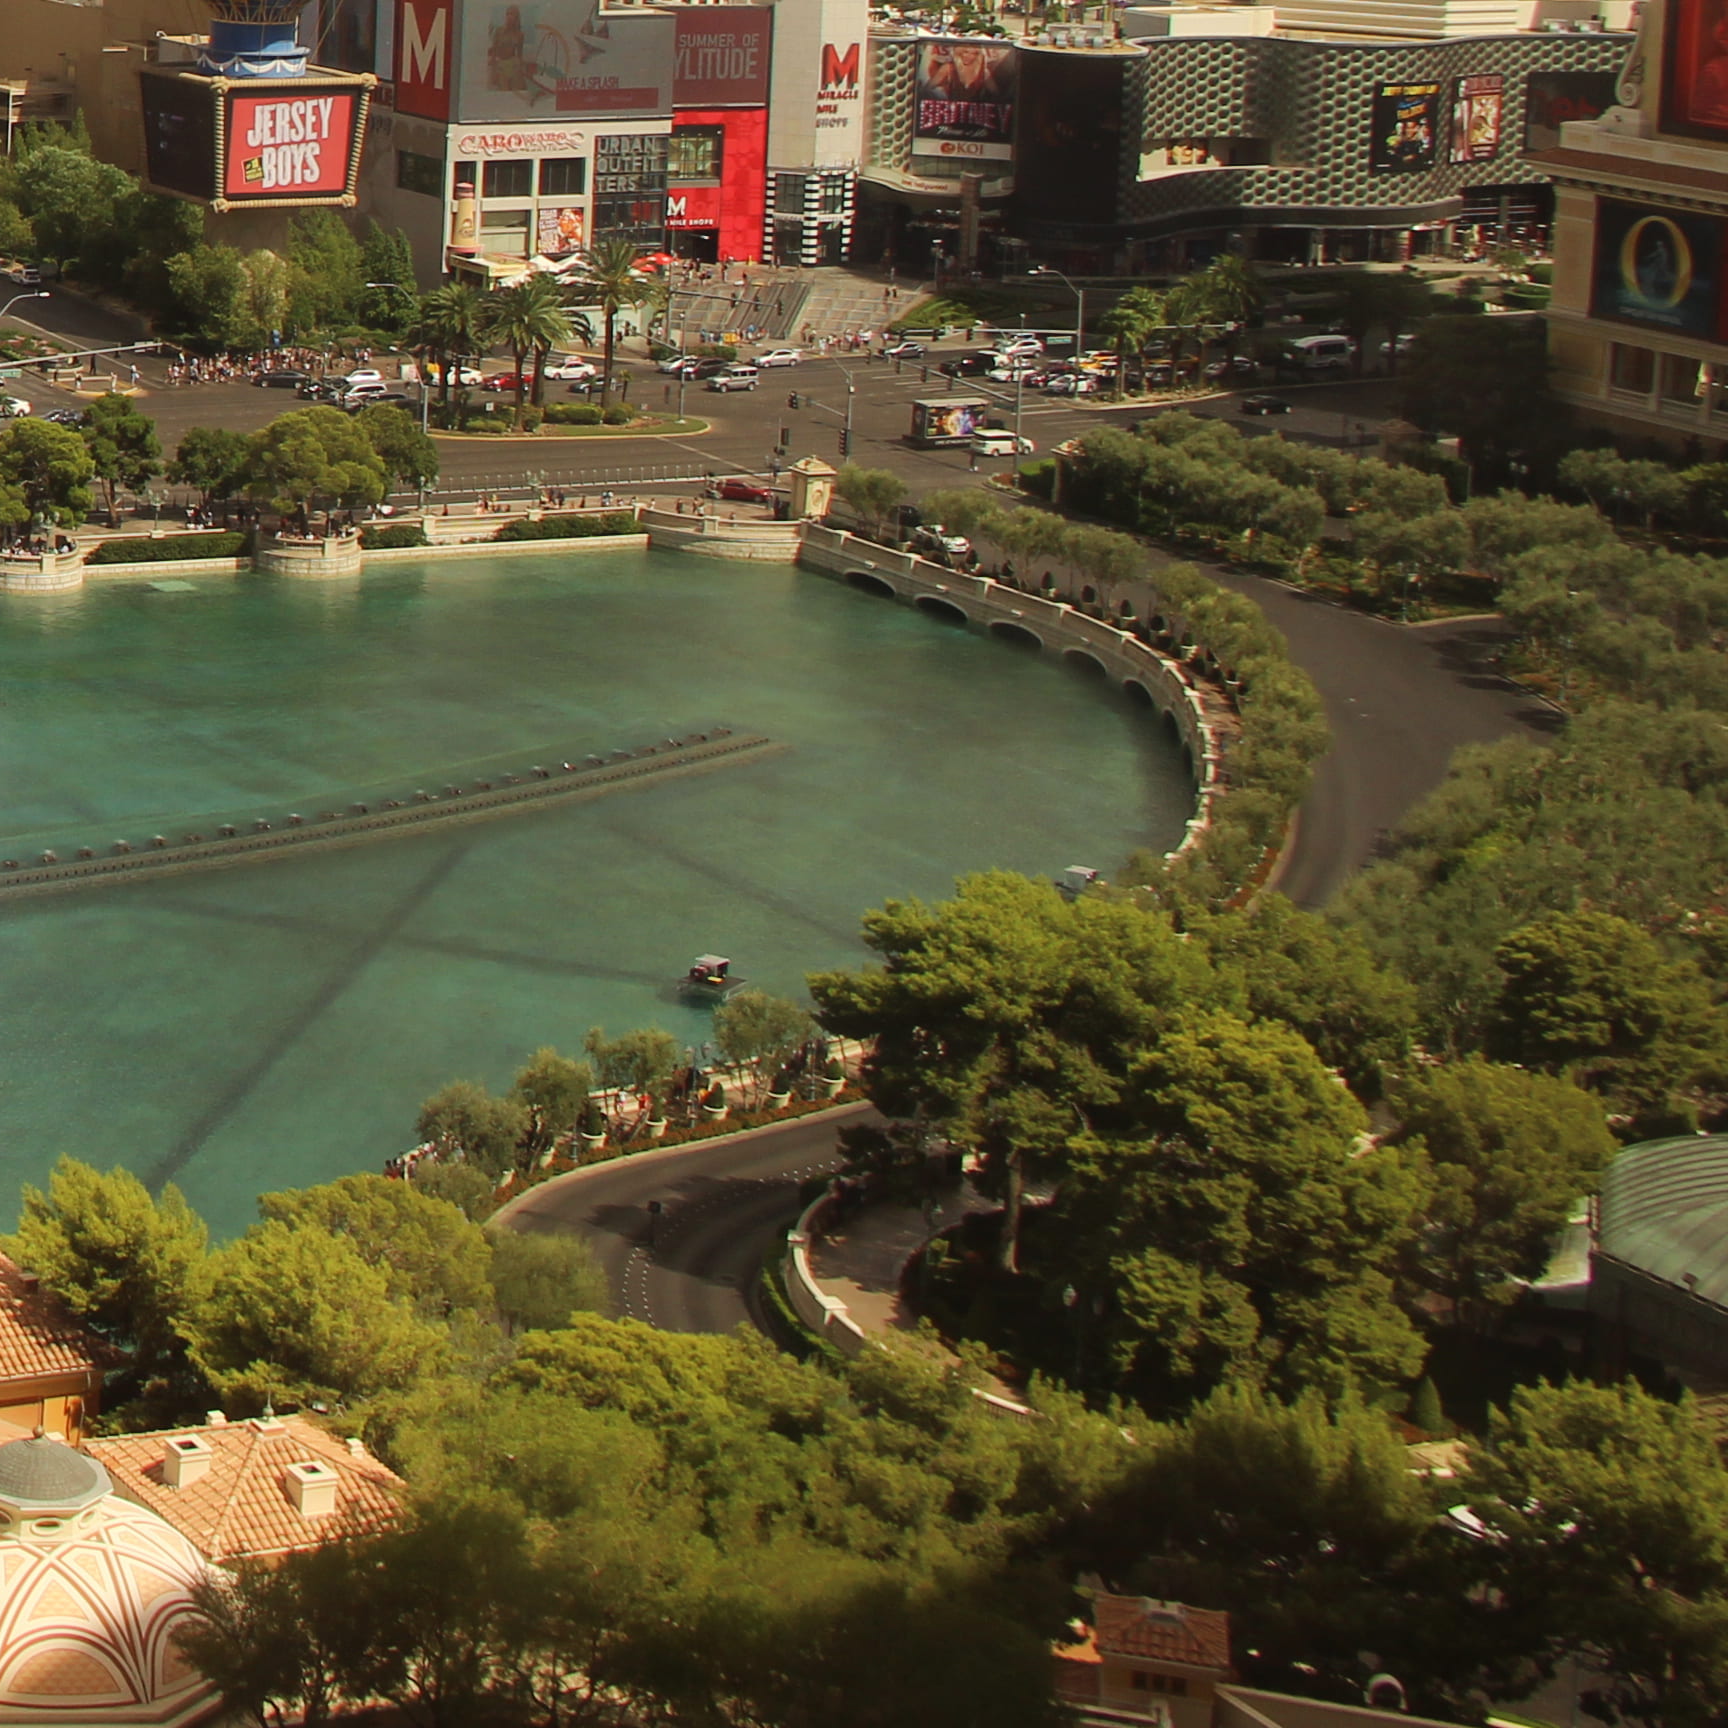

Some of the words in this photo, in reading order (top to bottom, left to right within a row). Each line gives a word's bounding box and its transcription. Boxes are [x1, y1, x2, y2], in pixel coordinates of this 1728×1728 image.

[401, 1, 446, 90] M
[678, 34, 736, 48] SUMMER
[743, 33, 759, 47] OF
[821, 42, 860, 90] M
[246, 96, 334, 148] JERSEY
[597, 135, 658, 153] URBAN
[956, 142, 984, 155] KOI
[261, 141, 321, 189] BOYS
[597, 155, 658, 172] OUTFIT
[597, 176, 637, 192] TERS
[667, 196, 687, 216] M
